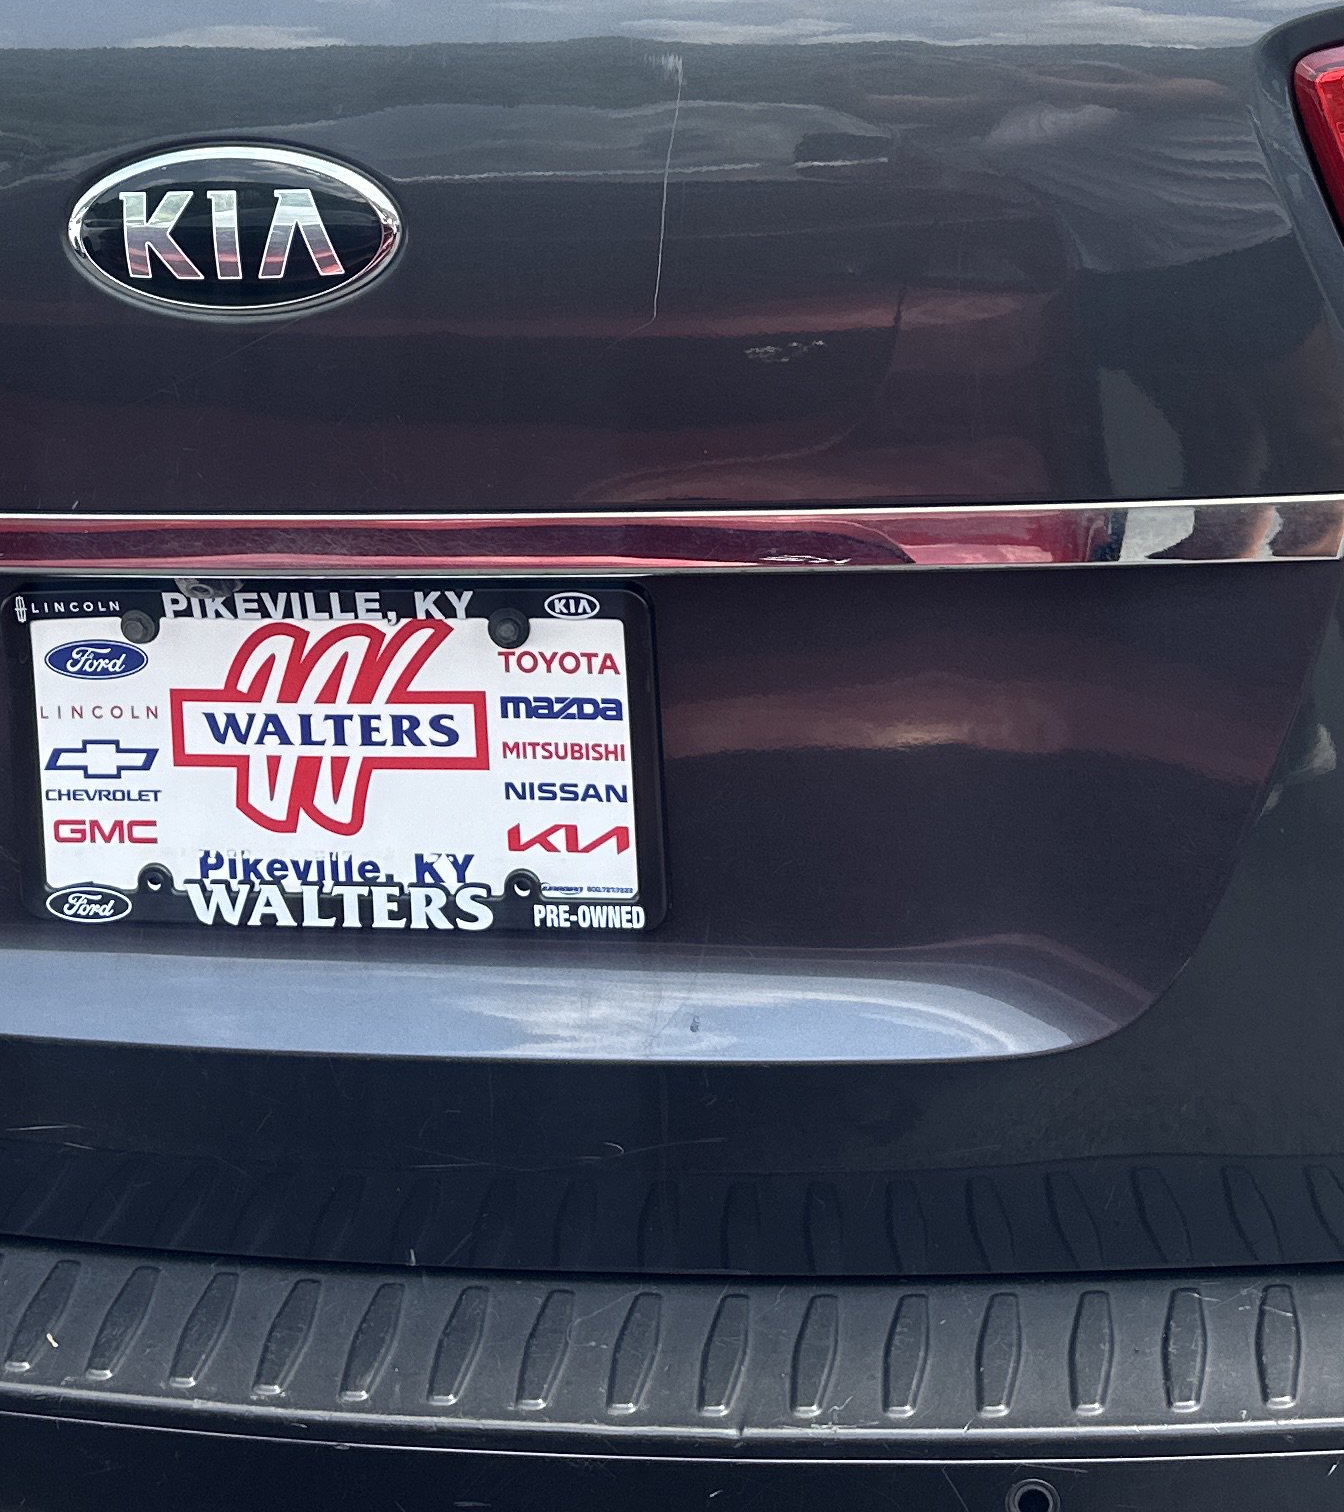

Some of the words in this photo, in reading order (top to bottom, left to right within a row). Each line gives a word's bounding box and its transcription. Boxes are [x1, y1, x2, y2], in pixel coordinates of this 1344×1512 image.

[119, 188, 345, 280] KIA
[31, 600, 121, 615] LINCOLN
[161, 591, 398, 626] PIKEVILLE,
[413, 590, 474, 620] KY
[553, 598, 592, 614] KIA
[66, 646, 126, 674] Ford
[498, 650, 620, 676] TOYOTA
[39, 705, 159, 720] LINCOLN
[201, 711, 460, 748] WALTERS
[501, 741, 626, 762] MITSUBISHI
[45, 789, 162, 802] CHEVROLET
[504, 781, 628, 803] NISSAN
[53, 819, 158, 844] GMC
[413, 852, 475, 884] KY
[63, 892, 115, 917] Ford
[183, 882, 494, 931] WALTERS
[533, 904, 645, 929] PRE-OWNED
